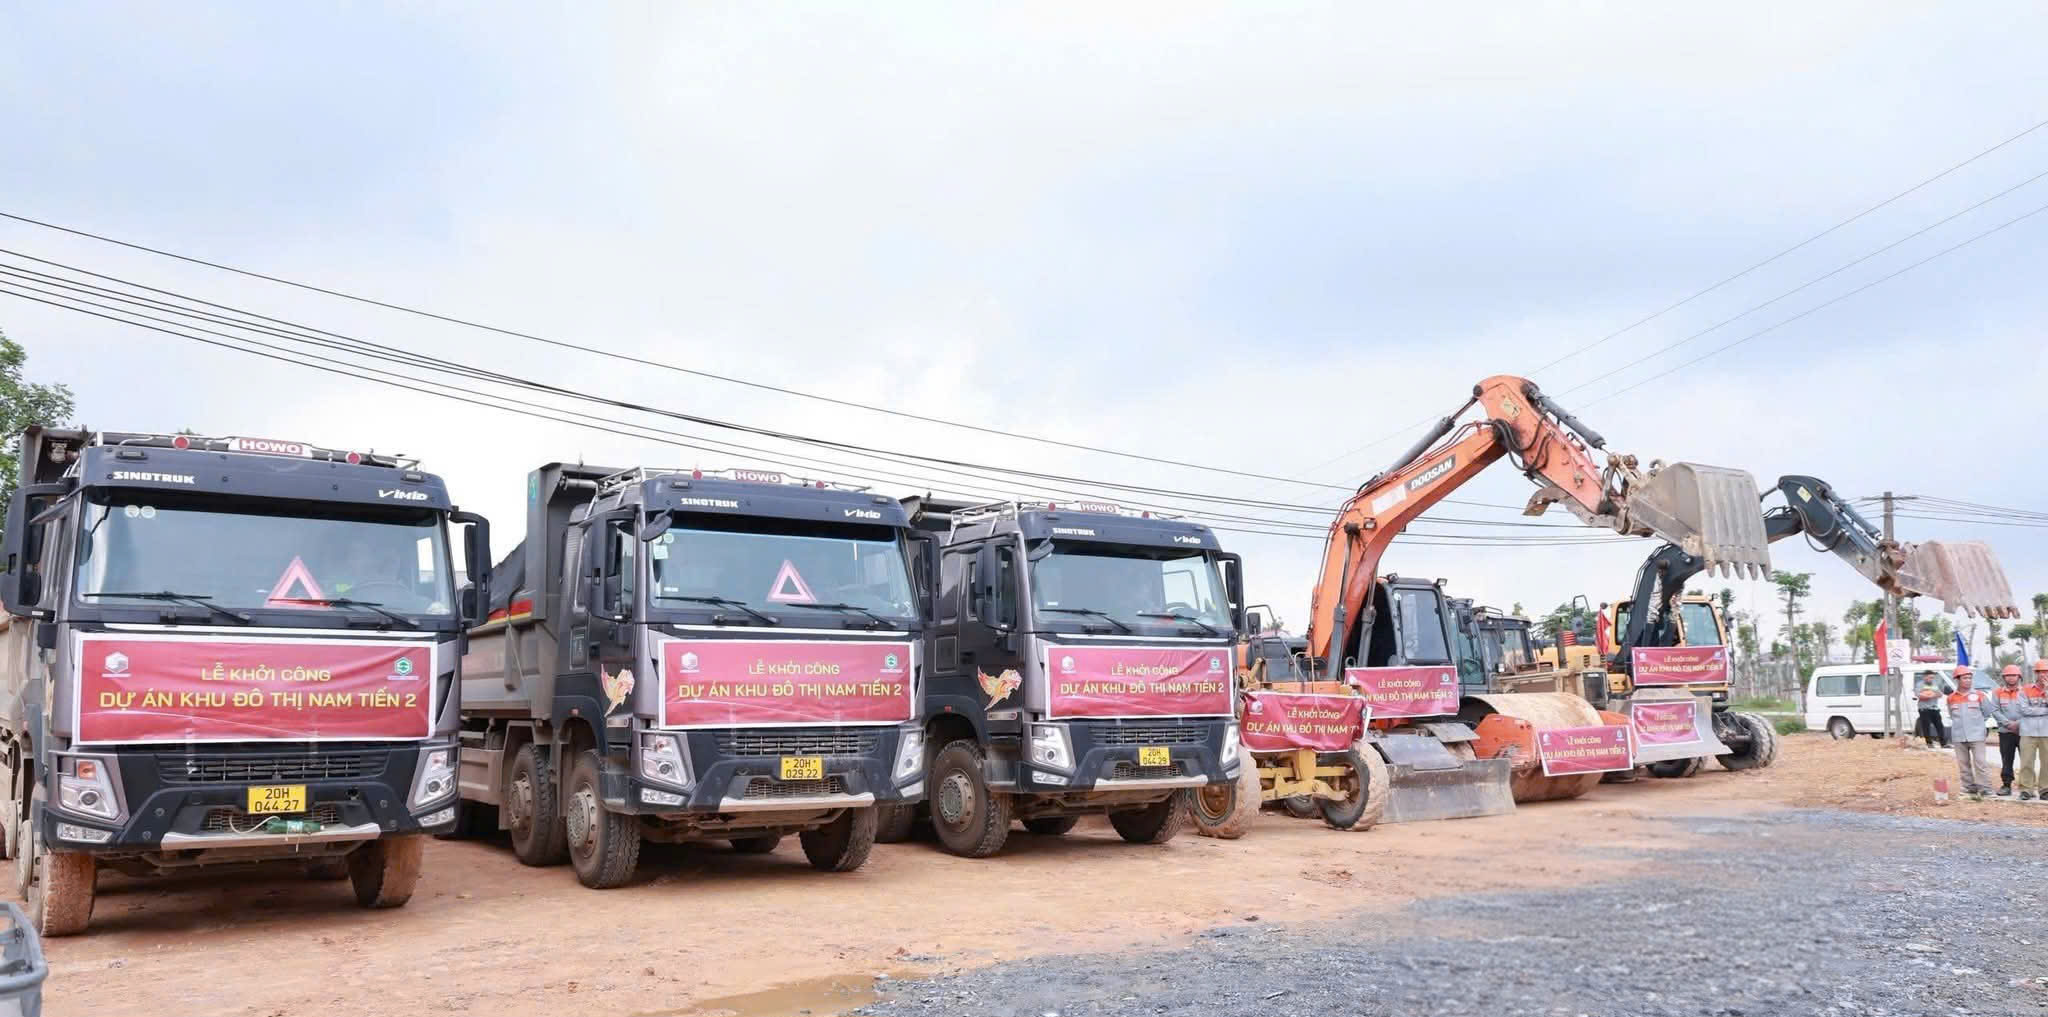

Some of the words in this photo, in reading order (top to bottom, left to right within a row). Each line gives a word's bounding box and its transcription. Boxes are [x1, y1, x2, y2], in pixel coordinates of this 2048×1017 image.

[241, 439, 300, 454] HOWO
[112, 471, 195, 485] SINOTRUK
[736, 471, 781, 483] HOWO
[1410, 458, 1453, 490] DOOSAN
[681, 497, 738, 509] SINOTRUK
[1082, 503, 1115, 513] HOWO
[201, 662, 225, 681] LỄ
[230, 664, 275, 681] KHỞI
[281, 666, 331, 682] CÔNG
[748, 658, 766, 675] LỄ
[768, 659, 801, 675] KHỞI
[805, 661, 840, 675] CÔNG
[679, 684, 705, 702] DỰ
[708, 680, 730, 697] ÁN
[735, 683, 767, 697] KHU
[772, 680, 794, 697] ĐÔ
[798, 683, 821, 700] THỊ
[825, 683, 856, 696] NAM
[860, 678, 890, 696] TIẾN
[893, 683, 902, 696] 2
[1083, 679, 1098, 694] ÁN
[1101, 682, 1126, 694] KHU
[1129, 679, 1146, 694] ĐÔ
[1149, 682, 1167, 696] THỊ
[1168, 682, 1191, 693] NAM
[1193, 678, 1216, 693] TIẾN
[1217, 682, 1225, 693] 2
[100, 691, 136, 711] DỰ
[142, 687, 173, 707] ÁN
[180, 692, 226, 707] KHU
[232, 688, 264, 707] ĐÔ
[270, 692, 302, 710] THỊ
[309, 692, 352, 707] NAM
[358, 686, 400, 707] TIẾN
[405, 693, 417, 708] 2
[1266, 720, 1280, 733] ÁN
[1327, 725, 1347, 734] NAM
[793, 758, 811, 768] 20H
[265, 788, 290, 800] 20H
[254, 800, 299, 812] 044.27
